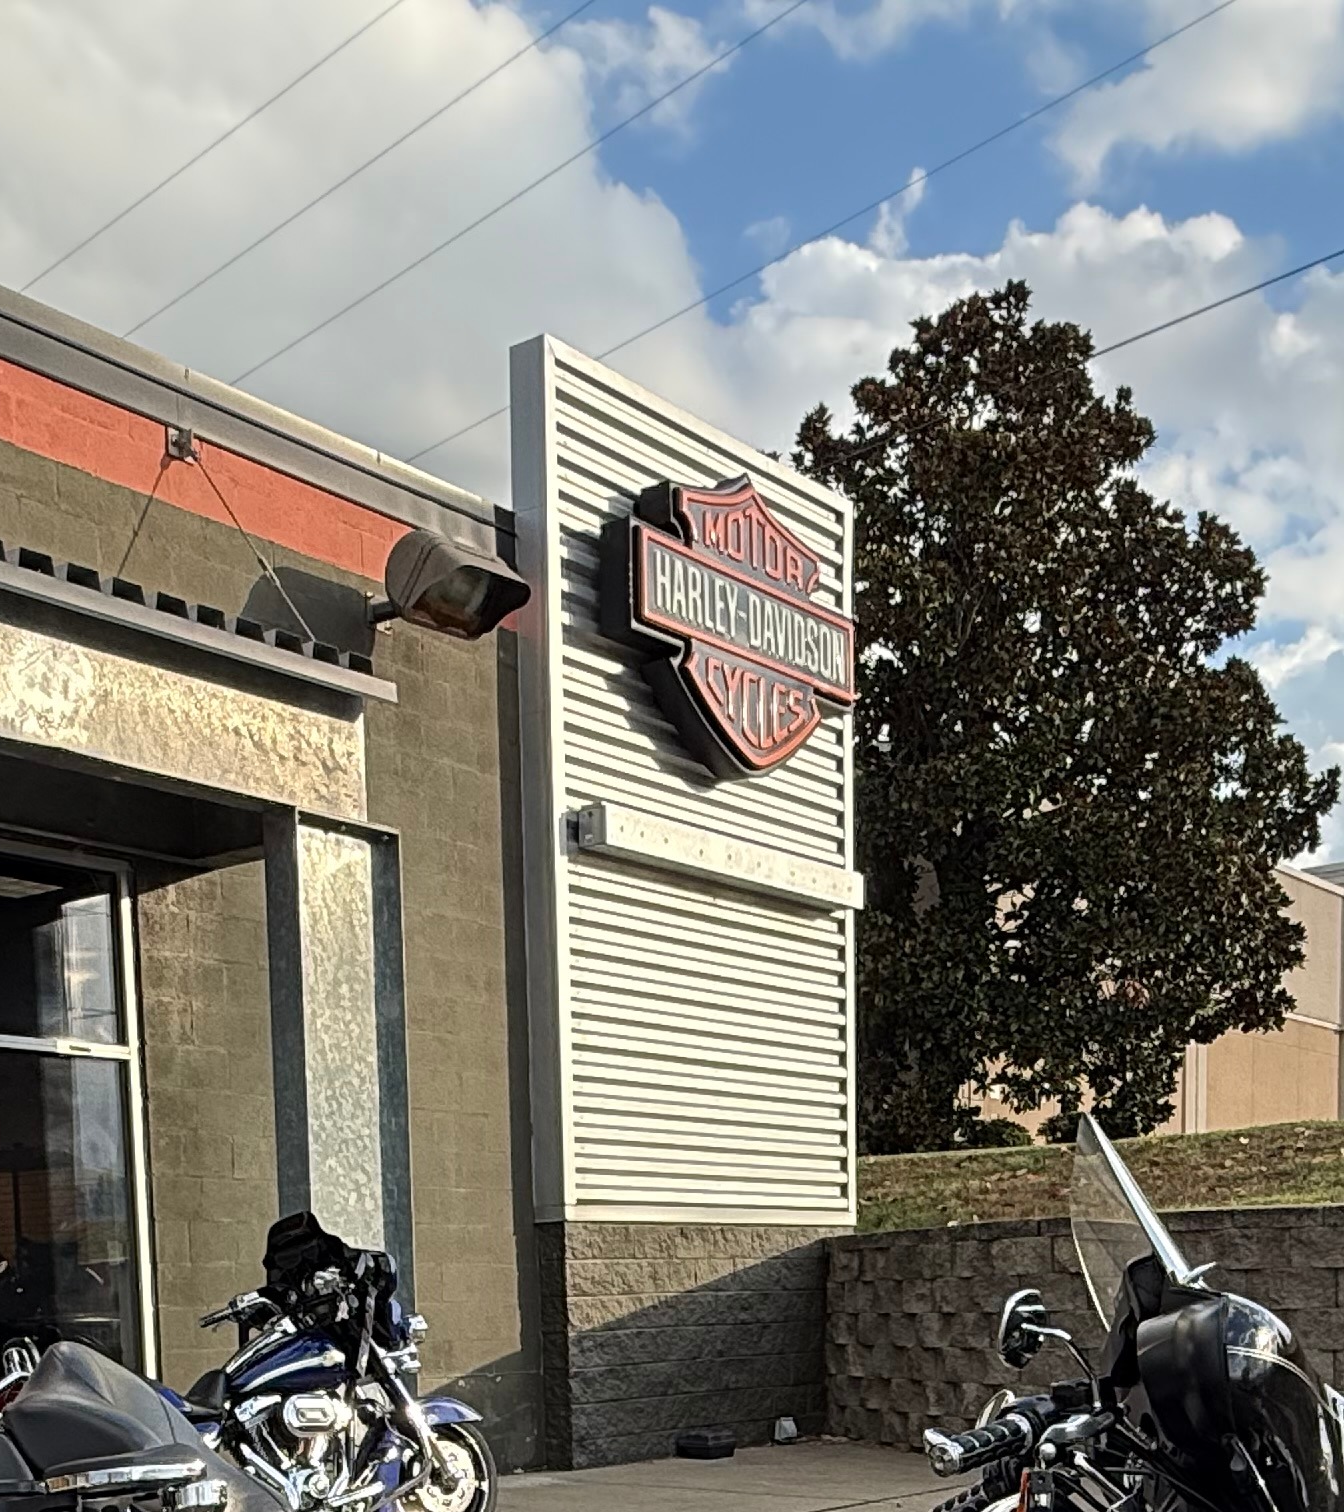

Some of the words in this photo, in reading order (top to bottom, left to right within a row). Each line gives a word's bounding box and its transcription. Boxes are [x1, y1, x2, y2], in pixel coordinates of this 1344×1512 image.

[704, 506, 804, 593] MOTOR
[655, 548, 846, 685] HARLEY-DAVIDSON
[707, 655, 805, 750] CYCLES
